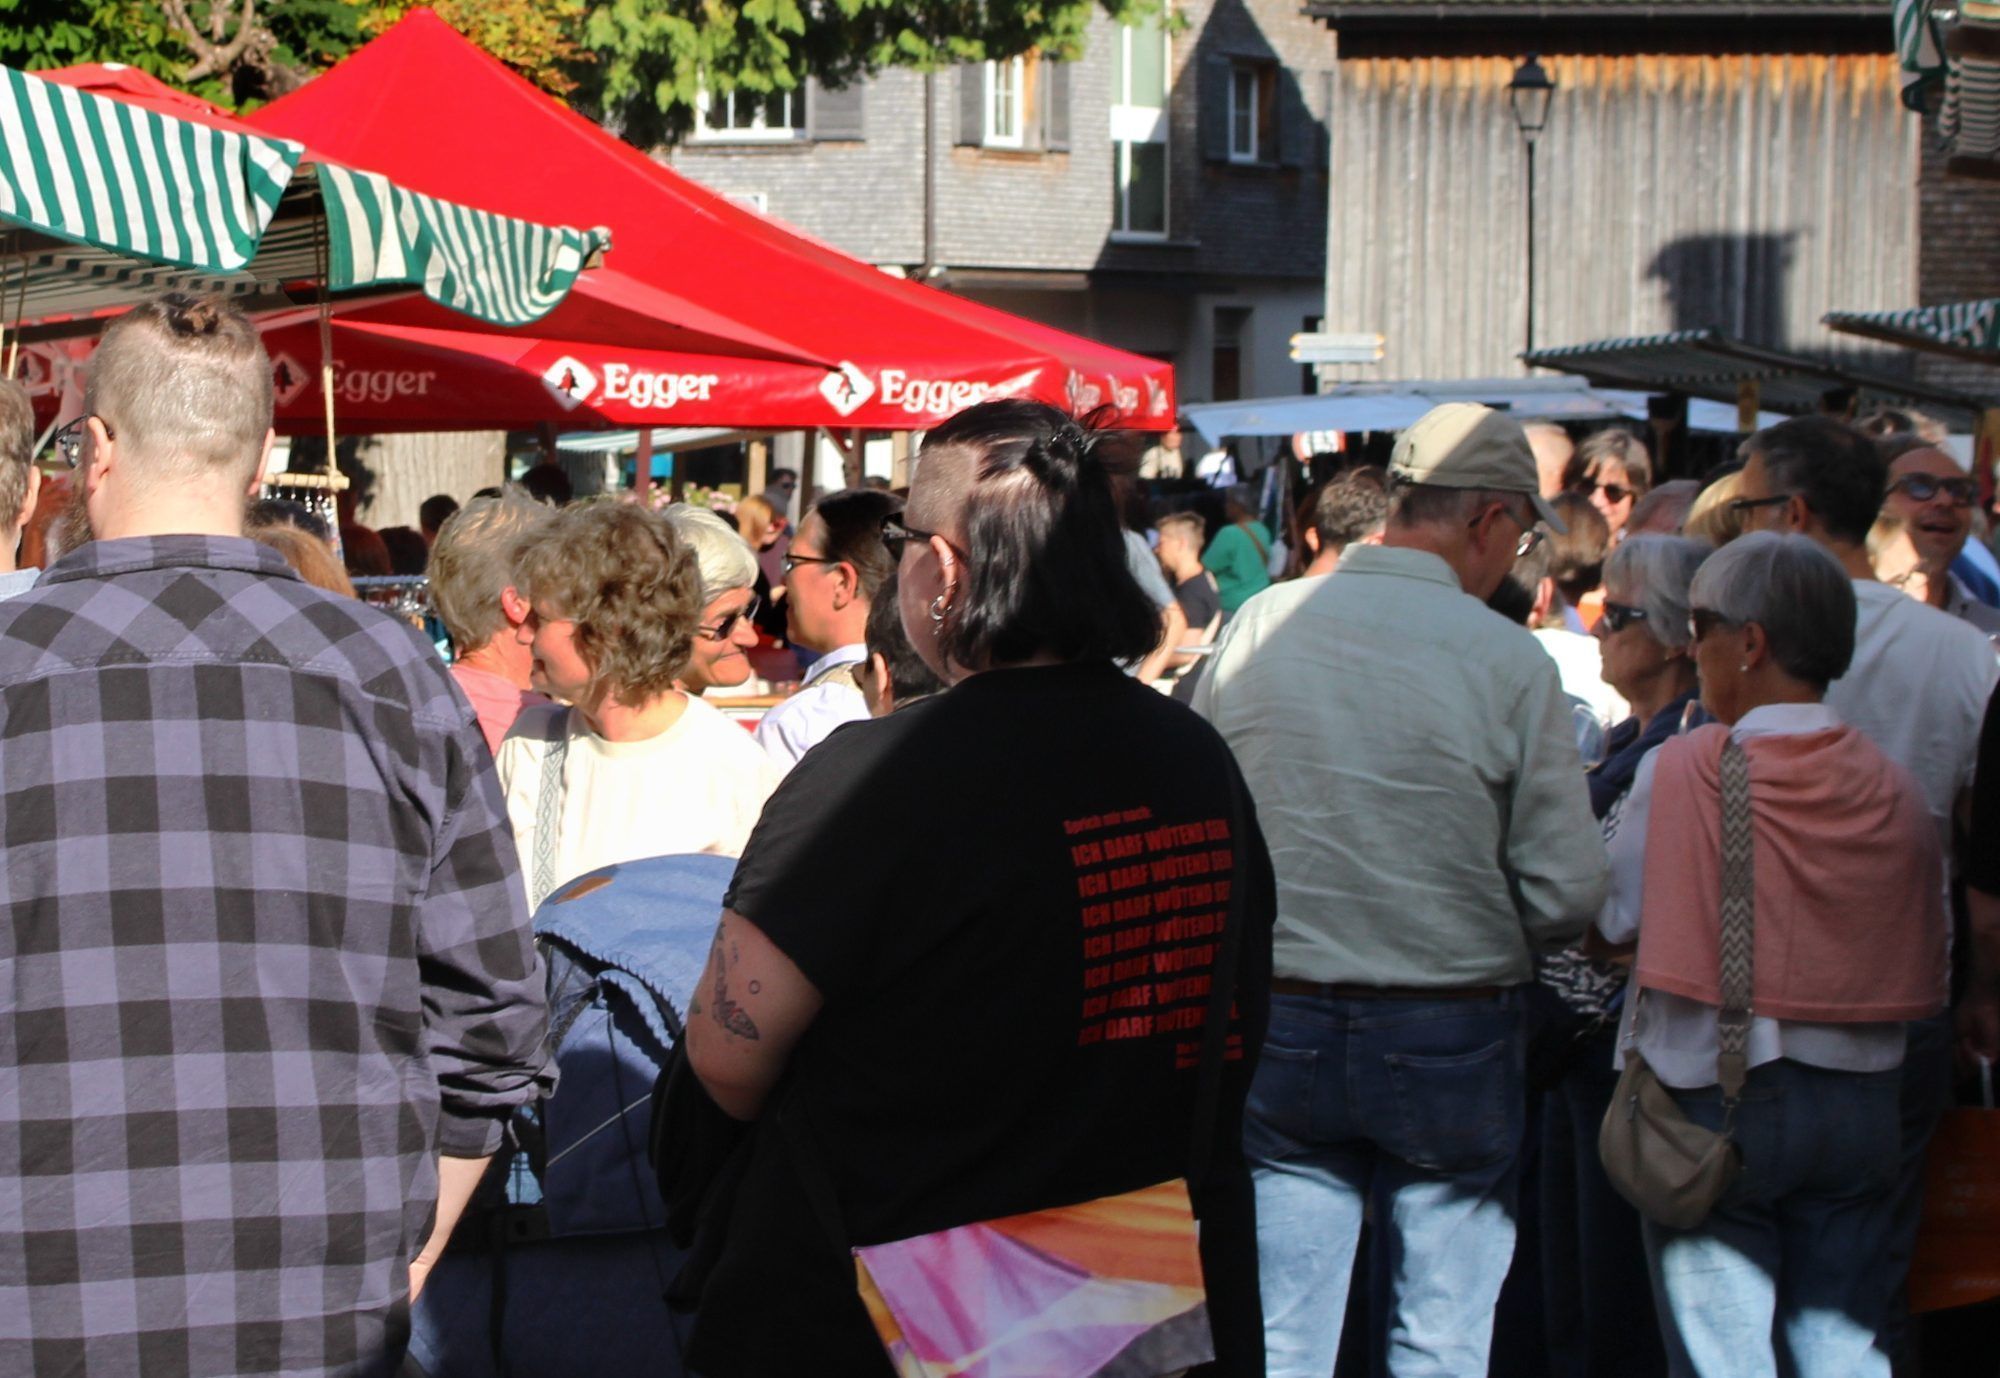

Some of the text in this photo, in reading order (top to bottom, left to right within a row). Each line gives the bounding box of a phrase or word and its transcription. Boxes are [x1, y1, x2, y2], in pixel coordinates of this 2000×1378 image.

[320, 359, 436, 402] Egger
[602, 363, 719, 409] Egger
[880, 369, 990, 414] Egger
[1072, 842, 1103, 867] ICH
[1104, 833, 1144, 859] DARF
[1145, 822, 1206, 851] WÜTEND
[1078, 873, 1108, 897] ICH
[1110, 865, 1149, 890] DARF
[1151, 853, 1210, 881] WÜTEND
[1082, 904, 1111, 928] ICH
[1113, 895, 1151, 921] DARF
[1154, 884, 1213, 913] WÜTEND
[1084, 935, 1112, 959] ICH
[1084, 966, 1111, 989] ICH
[1104, 1016, 1153, 1039] DARF
